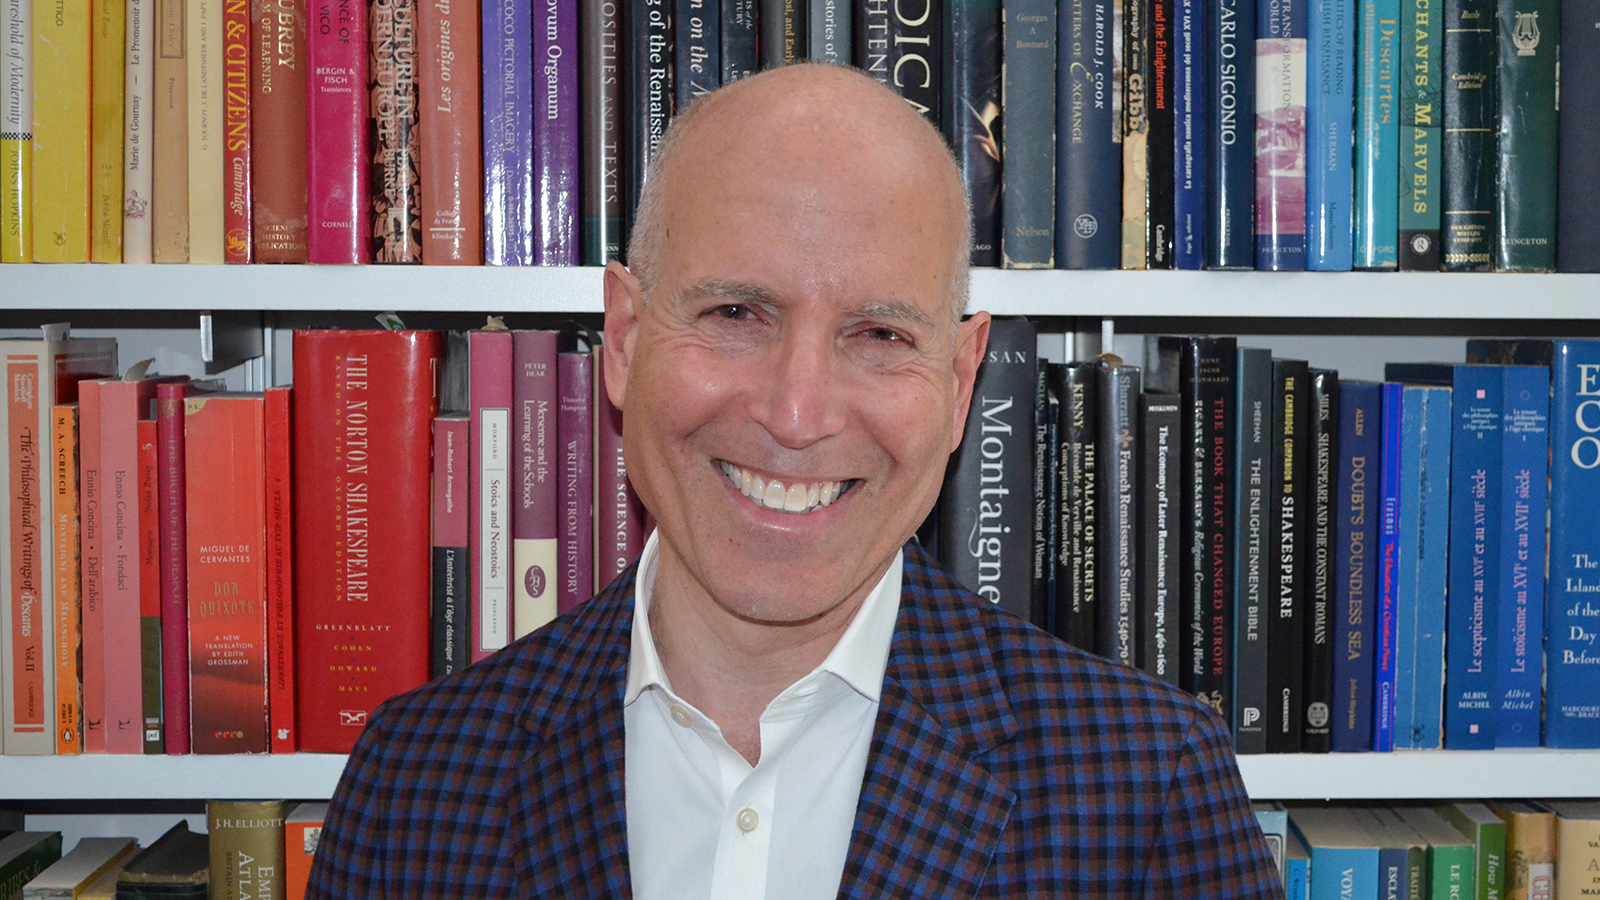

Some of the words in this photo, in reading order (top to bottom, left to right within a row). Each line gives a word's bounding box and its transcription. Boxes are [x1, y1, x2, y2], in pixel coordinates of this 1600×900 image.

[131, 7, 140, 52] Promenoir
[226, 20, 246, 40] &
[261, 18, 271, 33] OF
[320, 5, 331, 35] VICO
[649, 10, 665, 29] of
[691, 17, 703, 42] on
[1016, 13, 1048, 23] Georges
[1095, 4, 1105, 57] HAROLD
[1155, 4, 1166, 22] and
[1220, 0, 1236, 59] CARLO
[340, 28, 350, 44] OF
[649, 34, 666, 63] the
[1016, 40, 1049, 49] Bonnard
[1155, 24, 1166, 39] the
[1336, 33, 1344, 47] OF
[7, 48, 23, 61] of
[131, 55, 140, 65] Le
[262, 34, 272, 94] LEARNING
[437, 20, 455, 81] origines
[691, 45, 708, 73] the
[1093, 59, 1103, 68] J.
[1322, 29, 1330, 95] RENAISSANCE
[324, 76, 348, 84] FISCH
[544, 45, 562, 120] Organum
[1153, 40, 1167, 110] Enlightenment
[1336, 49, 1344, 95] READING
[1379, 18, 1396, 125] Descartes
[7, 63, 23, 125] Modernity
[227, 43, 247, 151] CITIZENS
[377, 57, 395, 141] EUROPE
[437, 86, 451, 113] Les
[1095, 72, 1104, 109] COOK
[1220, 64, 1236, 145] SIGONIO
[131, 95, 142, 131] Gournay
[131, 134, 139, 144] de
[1328, 122, 1337, 172] SHERMAN
[130, 147, 139, 171] Marie
[384, 147, 396, 196] BURKE
[230, 157, 245, 216] Cambridge
[1016, 226, 1049, 237] Nelson
[346, 354, 368, 390] THE
[1284, 377, 1295, 391] THE
[335, 408, 342, 426] ON
[1072, 383, 1083, 428] KENNY
[1118, 375, 1131, 427] Sharratt
[1213, 399, 1224, 430] THE
[1283, 394, 1295, 435] CAMBRIDGE
[58, 417, 66, 429] M.
[346, 400, 368, 474] NORTON
[521, 400, 534, 441] Learning
[537, 400, 548, 446] Mersenne
[1037, 424, 1048, 441] The
[1158, 426, 1168, 444] The
[1252, 400, 1262, 443] SHEEHAN
[1355, 408, 1364, 436] ALLEN
[20, 427, 33, 454] The
[58, 433, 66, 444] A.
[523, 443, 535, 453] of
[537, 447, 548, 465] and
[1084, 442, 1094, 469] THE
[1213, 436, 1224, 476] BOOK
[58, 448, 66, 495] SCREECH
[523, 456, 535, 471] the
[537, 467, 548, 483] the
[567, 440, 577, 497] WRITING
[1035, 443, 1046, 497] Renaissance
[1058, 442, 1070, 501] Conceptions
[1118, 450, 1131, 492] French
[1155, 446, 1167, 490] Economy
[1250, 458, 1262, 485] THE
[1283, 438, 1294, 482] COMPANION
[14, 455, 35, 530] Philosophical
[87, 469, 97, 498] Ennio
[115, 470, 126, 498] Ennio
[490, 479, 501, 508] Stoics
[523, 471, 535, 509] Schools
[966, 396, 1014, 604] Montaigne
[1084, 472, 1094, 523] PALACE
[1157, 491, 1168, 502] of
[1283, 484, 1294, 494] TO
[1351, 456, 1366, 525] DOUBT'S
[87, 500, 97, 539] Concina
[116, 501, 126, 540] Concina
[490, 510, 501, 529] and
[567, 500, 577, 536] FROM
[1035, 499, 1046, 530] Notion
[1060, 502, 1070, 512] of
[1157, 503, 1168, 529] Later
[1213, 483, 1224, 528] THAT
[59, 514, 69, 574] MONTAIGNE
[346, 482, 368, 602] SHAKESPEARE
[1035, 532, 1047, 542] of
[1058, 514, 1070, 566] Knowledge
[1084, 525, 1094, 543] OF
[1118, 494, 1131, 566] Renaissance
[1248, 488, 1261, 602] ENLIGHTENMENT
[20, 532, 35, 579] Writings
[200, 545, 235, 554] MIGUEL
[239, 545, 251, 553] DE
[200, 554, 251, 564] CERVANTES
[490, 531, 500, 578] Neostoics
[1034, 543, 1045, 579] Woman
[1157, 531, 1167, 588] Renaissance
[1280, 496, 1295, 619] SHAKESPEARE
[1572, 554, 1598, 568] The
[87, 556, 99, 611] Dell'arabico
[116, 554, 127, 591] Fondaci
[335, 541, 343, 602] EDITION
[567, 540, 578, 595] HISTORY
[1084, 546, 1094, 602] SECRETS
[1213, 533, 1223, 609] CHANGED
[1348, 531, 1364, 625] BOUNDLESS
[20, 579, 37, 592] of
[60, 577, 68, 597] AND
[214, 582, 239, 597] DON
[1118, 568, 1131, 613] Studies
[21, 592, 36, 637] Descartes
[200, 600, 255, 617] QUIXOTE
[1154, 589, 1167, 627] Europe,
[1247, 606, 1259, 641] BIBLE
[1567, 603, 1580, 617] of
[1582, 603, 1600, 616] the
[61, 602, 70, 667] MELANCHOLY
[316, 623, 391, 631] GREENBLATT
[1568, 627, 1597, 643] Day
[205, 642, 254, 650] TRANSLATION
[207, 658, 250, 666] GROSSMAN
[1212, 616, 1223, 676] EUROPE
[1347, 630, 1363, 661] SEA
[1458, 701, 1490, 709] MICHEL
[1462, 691, 1488, 699] ALBIN
[1502, 700, 1534, 710] Michel
[1505, 689, 1531, 698] Albin
[236, 818, 283, 828] ELLIOTT
[1488, 854, 1500, 884] How
